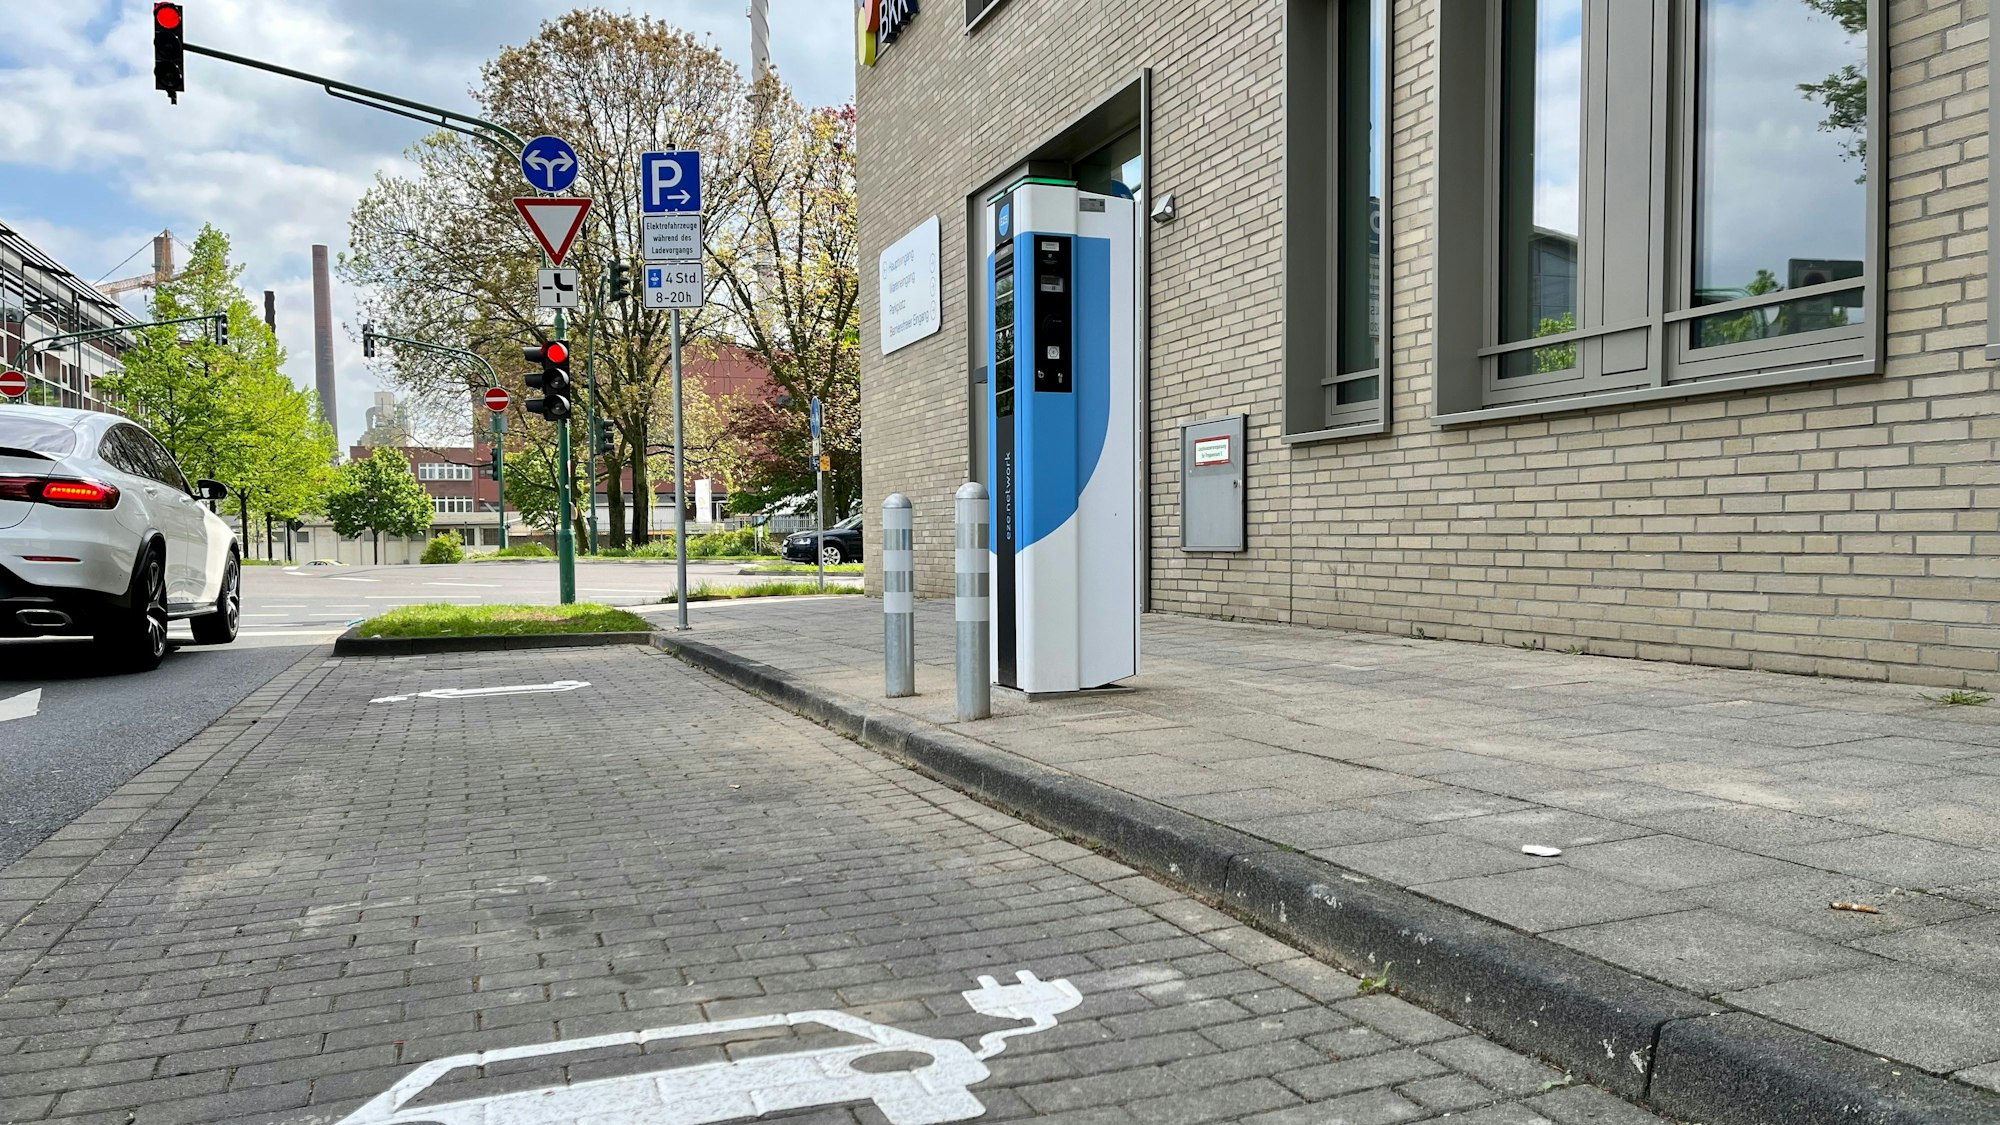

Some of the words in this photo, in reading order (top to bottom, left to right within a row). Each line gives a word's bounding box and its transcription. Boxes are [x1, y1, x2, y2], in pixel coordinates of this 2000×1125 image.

[651, 160, 682, 205] P
[646, 222, 697, 230] Elektrofahrzeuge
[651, 246, 693, 255] Ladevorgangs
[666, 272, 673, 283] 4
[676, 272, 699, 284] Std.
[656, 292, 691, 303] 8-20h
